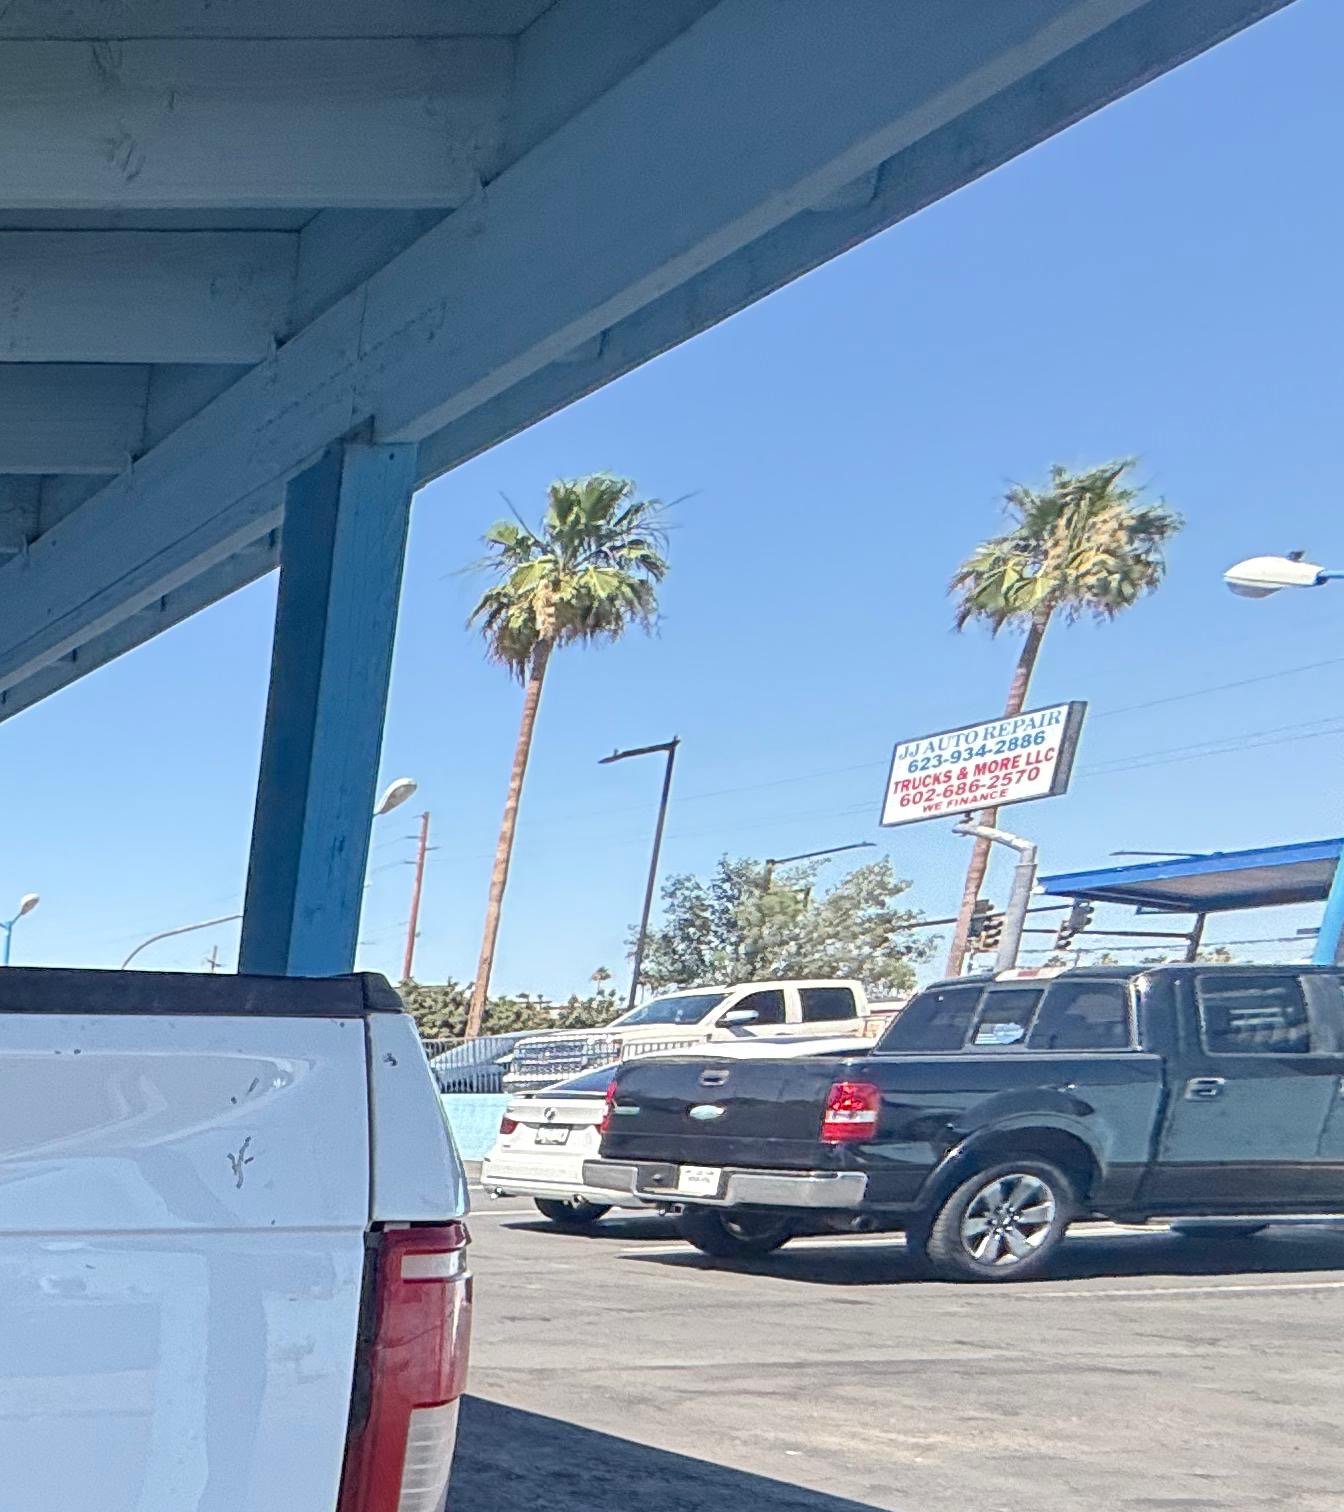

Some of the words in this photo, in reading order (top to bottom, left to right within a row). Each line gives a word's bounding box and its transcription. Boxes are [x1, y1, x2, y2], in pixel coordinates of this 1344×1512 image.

[899, 743, 921, 760] JJ
[923, 730, 979, 755] AUTO
[982, 710, 1062, 741] REPAIR
[908, 730, 1046, 774] 623-934-2886
[893, 770, 952, 795] TRUCKS
[956, 766, 968, 781] &
[973, 754, 1022, 777] MORE
[1025, 747, 1055, 766] LLC
[899, 766, 1041, 808] 602-686-2570
[922, 802, 943, 813] WE
[946, 788, 1009, 809] FINANCE
